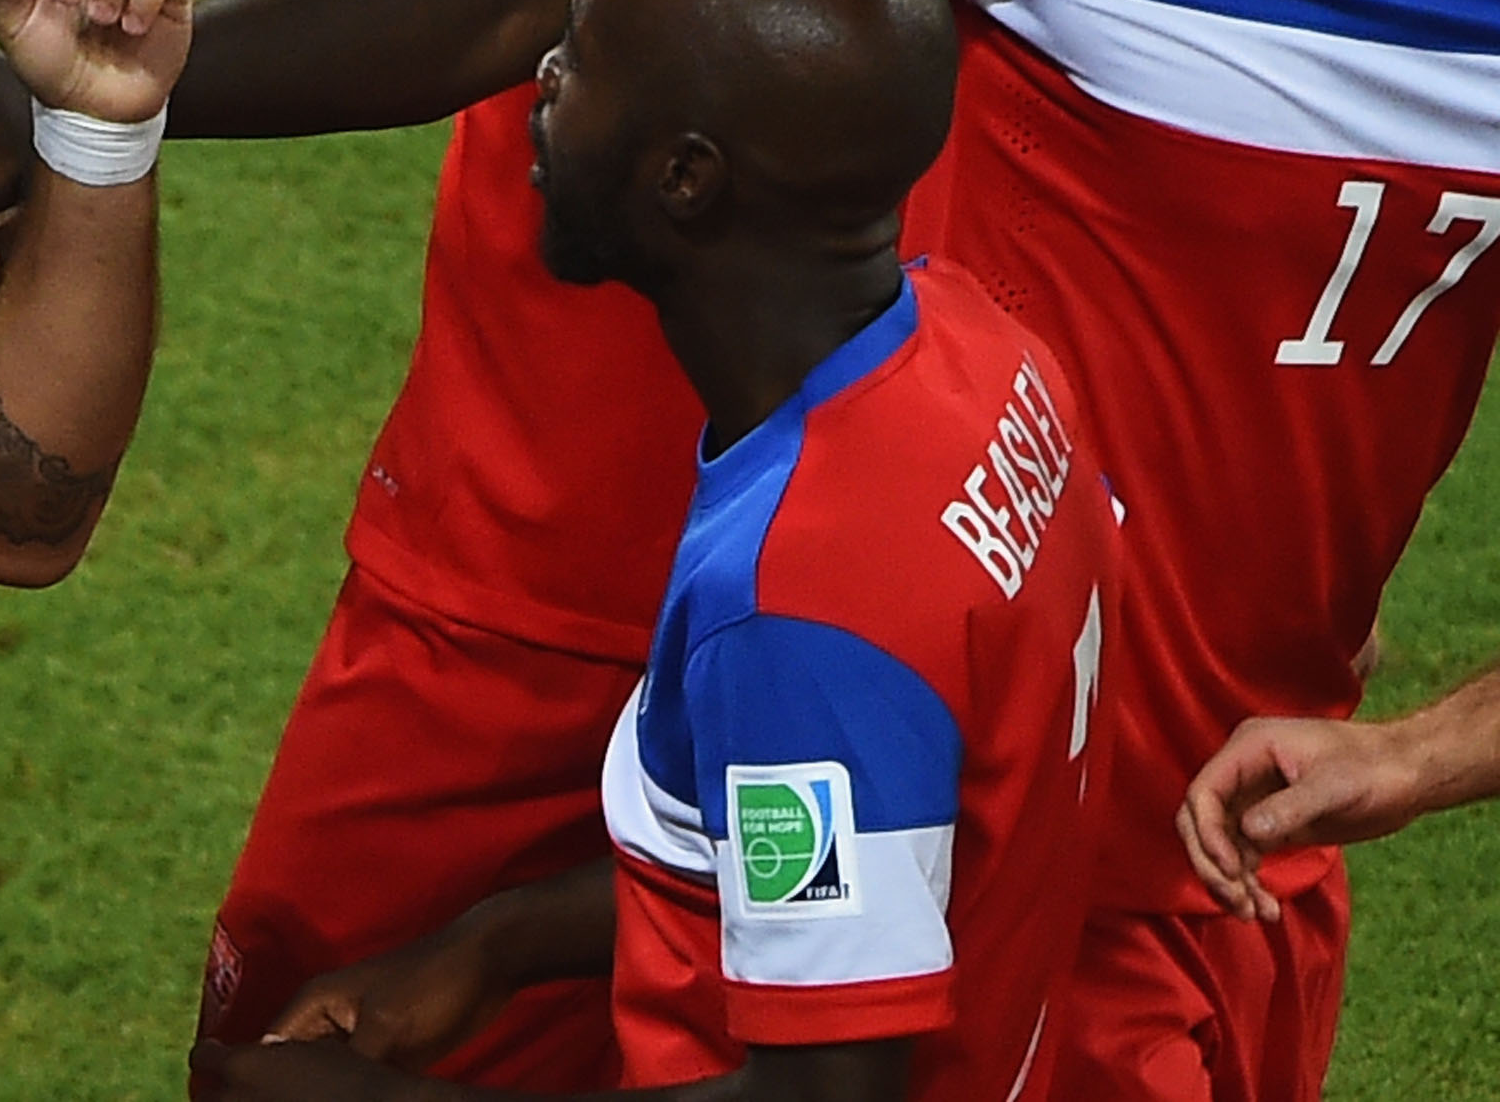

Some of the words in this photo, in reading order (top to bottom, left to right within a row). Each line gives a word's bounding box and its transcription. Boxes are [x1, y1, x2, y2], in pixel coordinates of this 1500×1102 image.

[1274, 180, 1500, 365] 17
[940, 349, 1073, 601] BEASLEY
[741, 805, 805, 820] FOOTBALL
[743, 821, 766, 835] FOR
[767, 819, 803, 835] HOPE
[806, 884, 839, 900] FIFA
